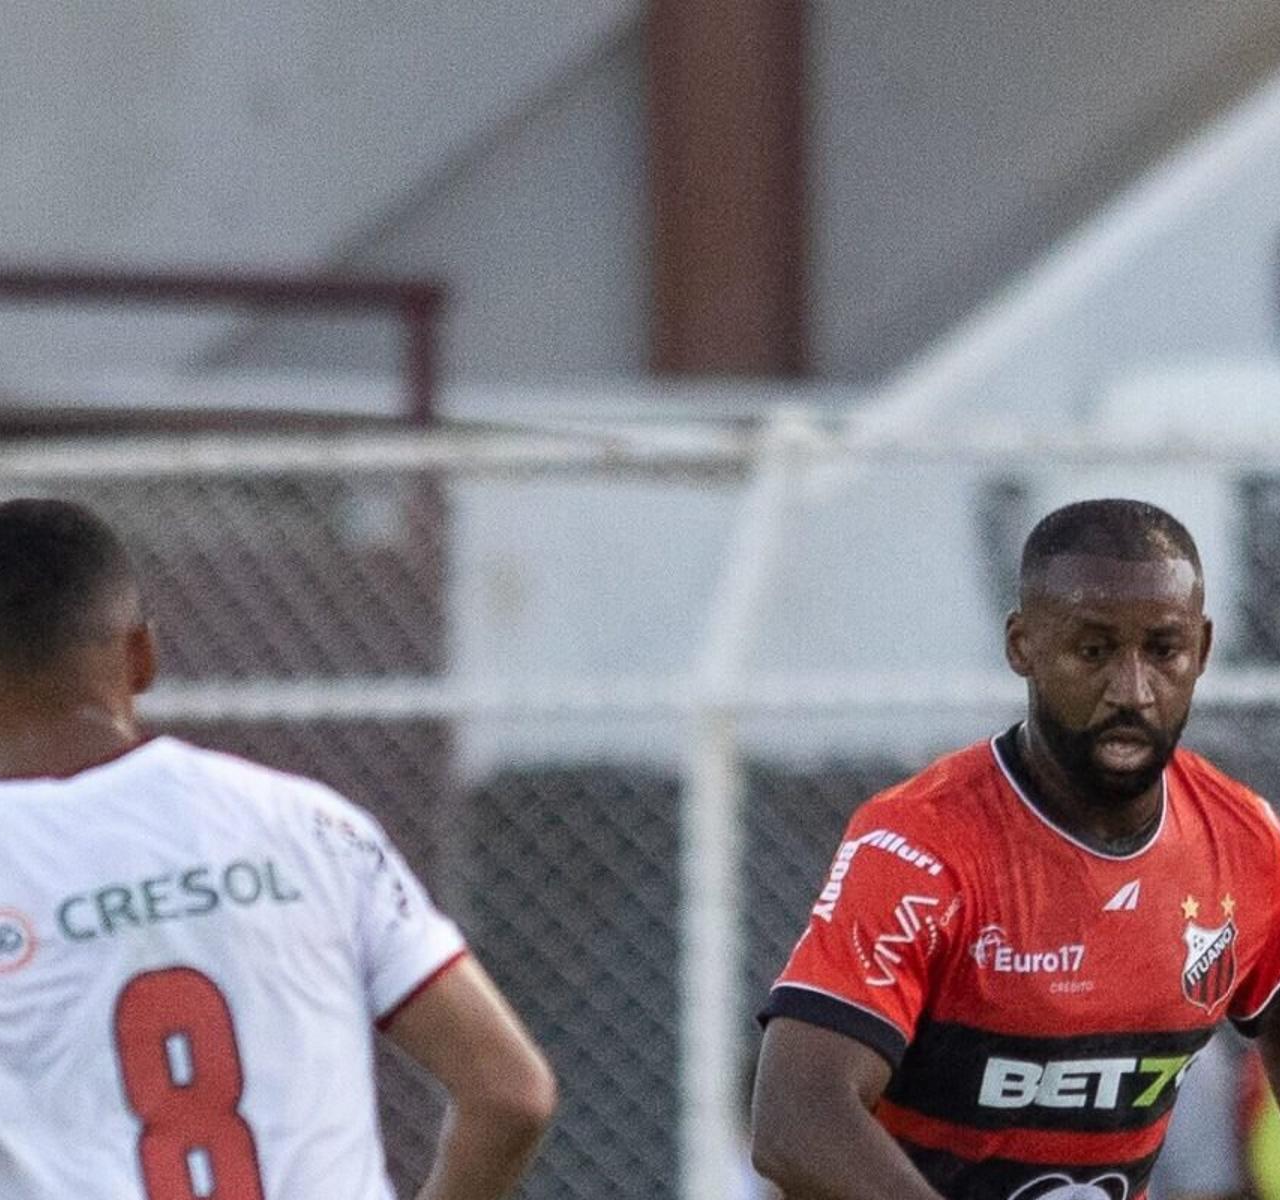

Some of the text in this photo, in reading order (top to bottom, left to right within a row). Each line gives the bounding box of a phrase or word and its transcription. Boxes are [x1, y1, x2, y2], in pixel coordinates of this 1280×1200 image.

[57, 860, 302, 942] CRESOL
[865, 895, 940, 986] VIVA
[994, 944, 1085, 973] Euro17
[1186, 927, 1234, 986] ITUANO
[977, 1056, 1194, 1109] BET7
